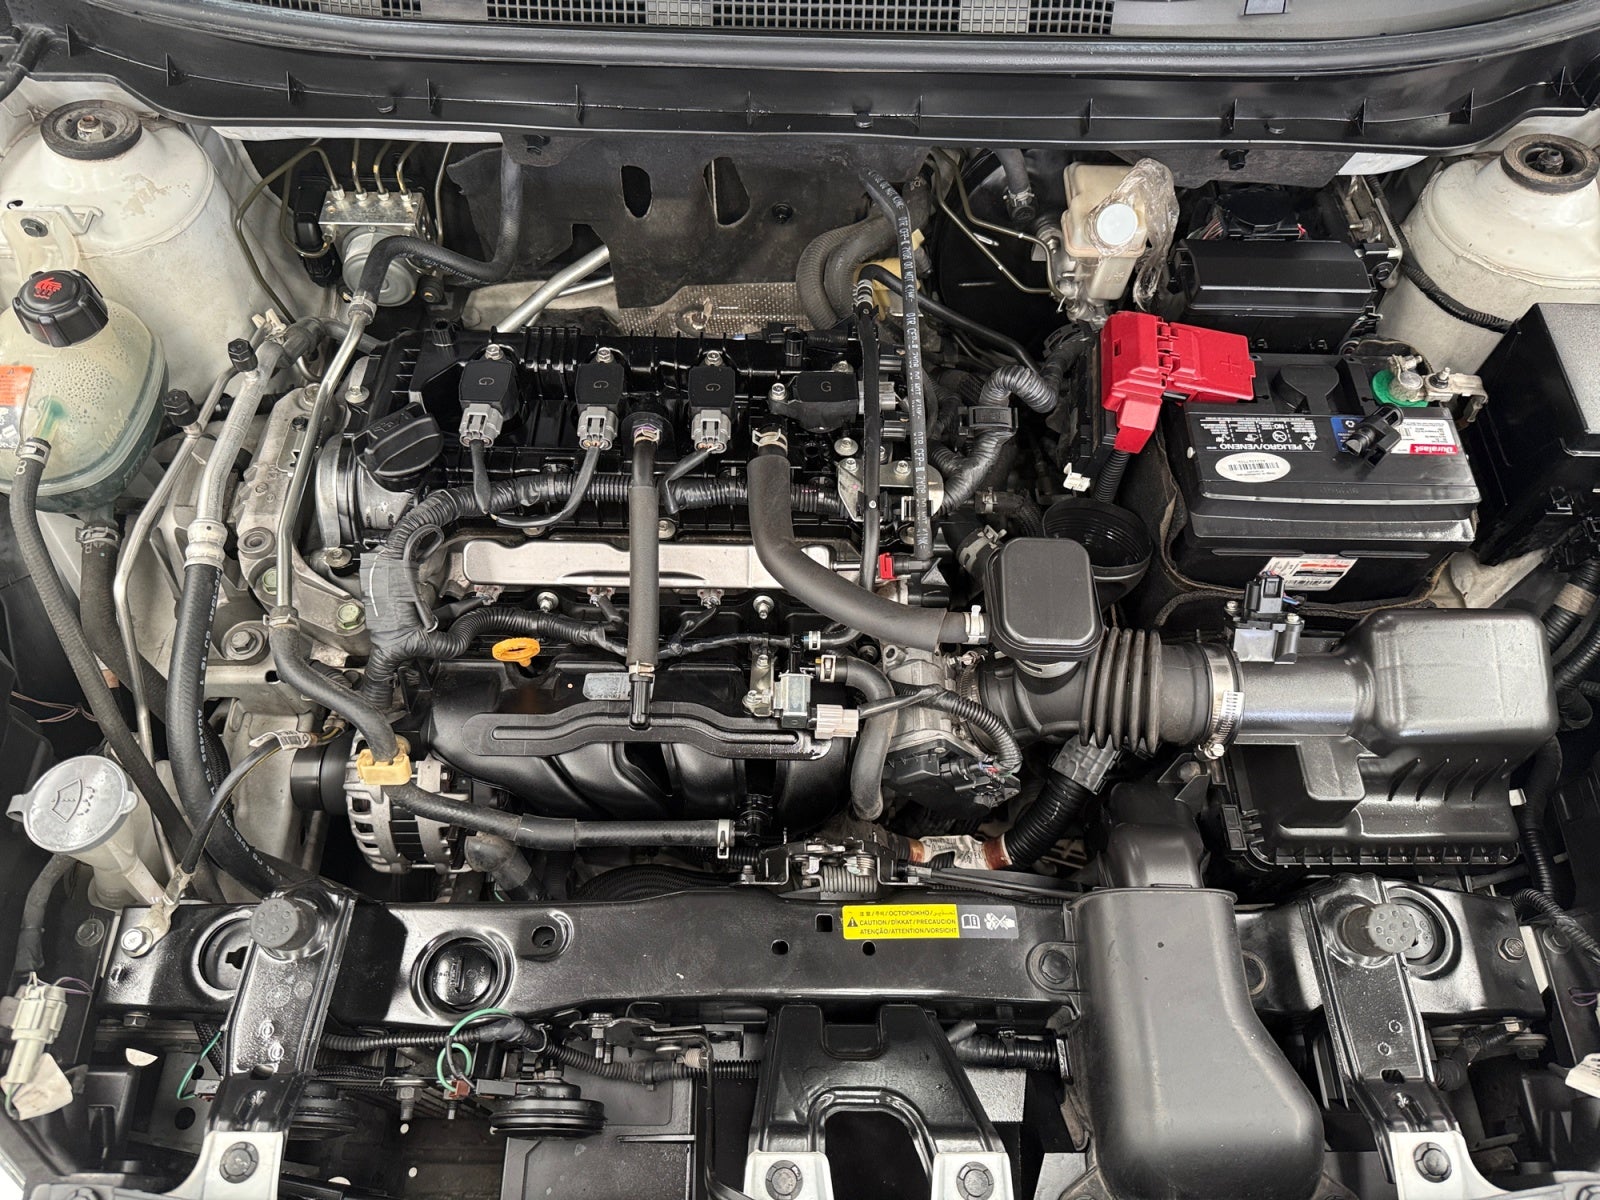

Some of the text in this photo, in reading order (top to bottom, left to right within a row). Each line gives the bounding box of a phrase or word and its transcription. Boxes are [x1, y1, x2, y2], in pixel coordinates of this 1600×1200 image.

[820, 381, 832, 392] G
[1219, 443, 1304, 451] PELIGRO/VENENO
[1414, 445, 1456, 454] Duralast
